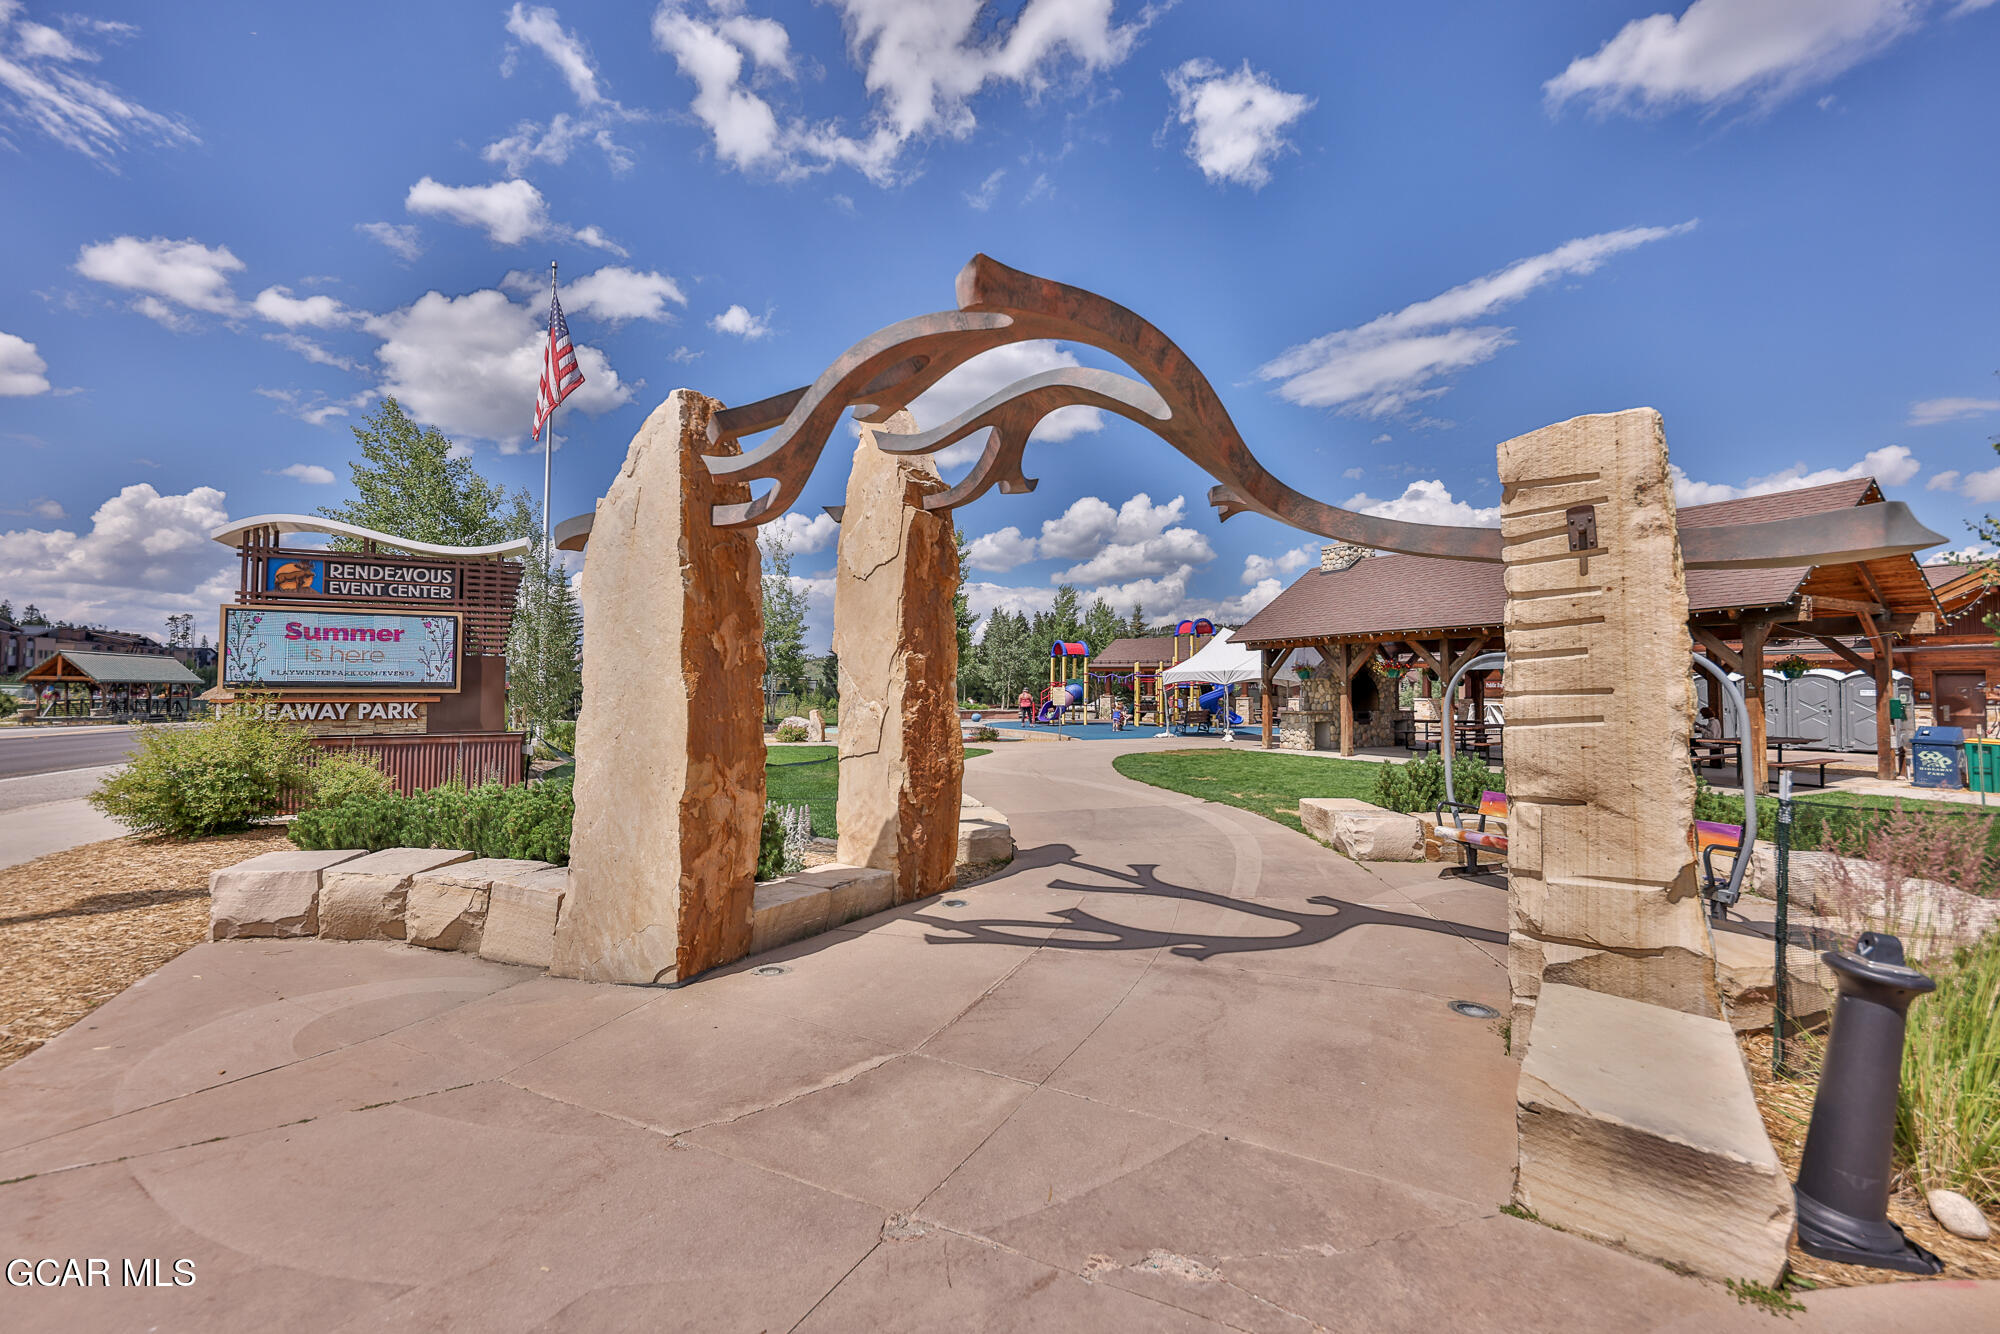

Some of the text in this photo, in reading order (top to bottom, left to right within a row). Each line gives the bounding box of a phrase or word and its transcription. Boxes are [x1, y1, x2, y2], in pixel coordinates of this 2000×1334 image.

[329, 581, 452, 599] EVENT CENTER
[285, 621, 405, 642] Summer
[305, 644, 385, 663] is here
[358, 702, 419, 719] PARK
